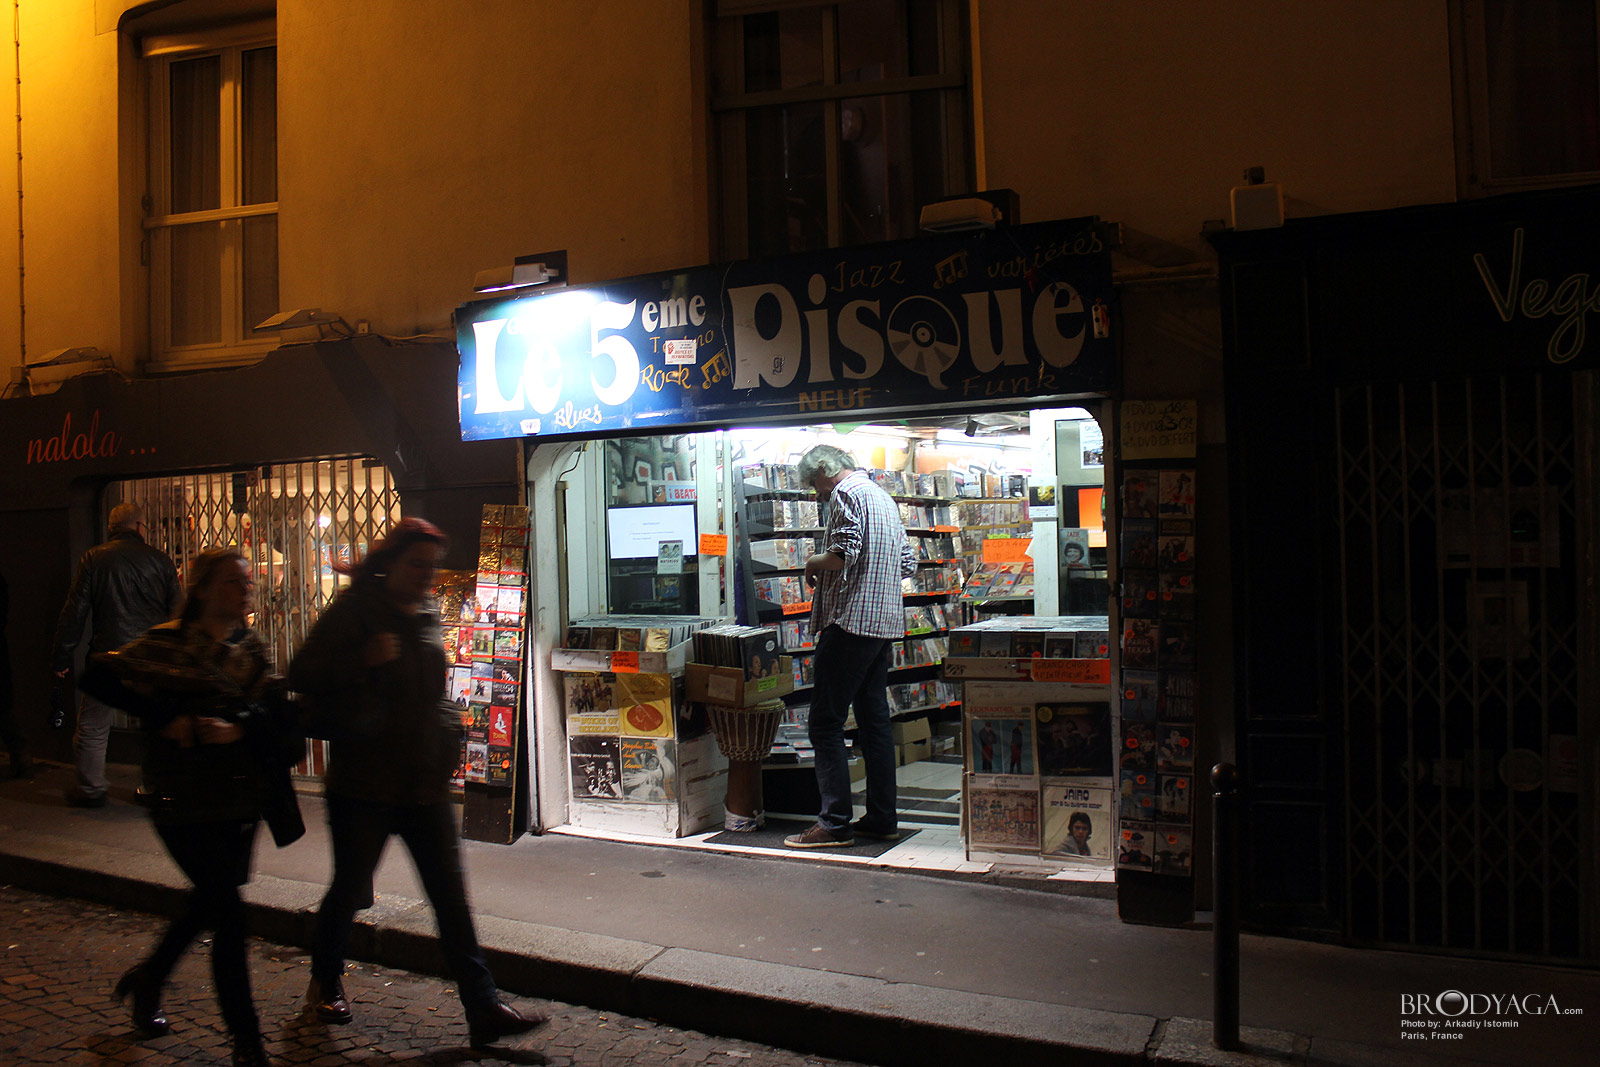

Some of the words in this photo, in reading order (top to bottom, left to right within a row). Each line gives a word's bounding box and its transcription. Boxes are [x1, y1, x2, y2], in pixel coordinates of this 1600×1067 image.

[831, 259, 905, 293] Jazz
[472, 318, 563, 415] Le
[961, 364, 1061, 397] Funk
[555, 400, 602, 429] Blues
[800, 387, 872, 412] NEUF
[26, 408, 123, 464] nalola
